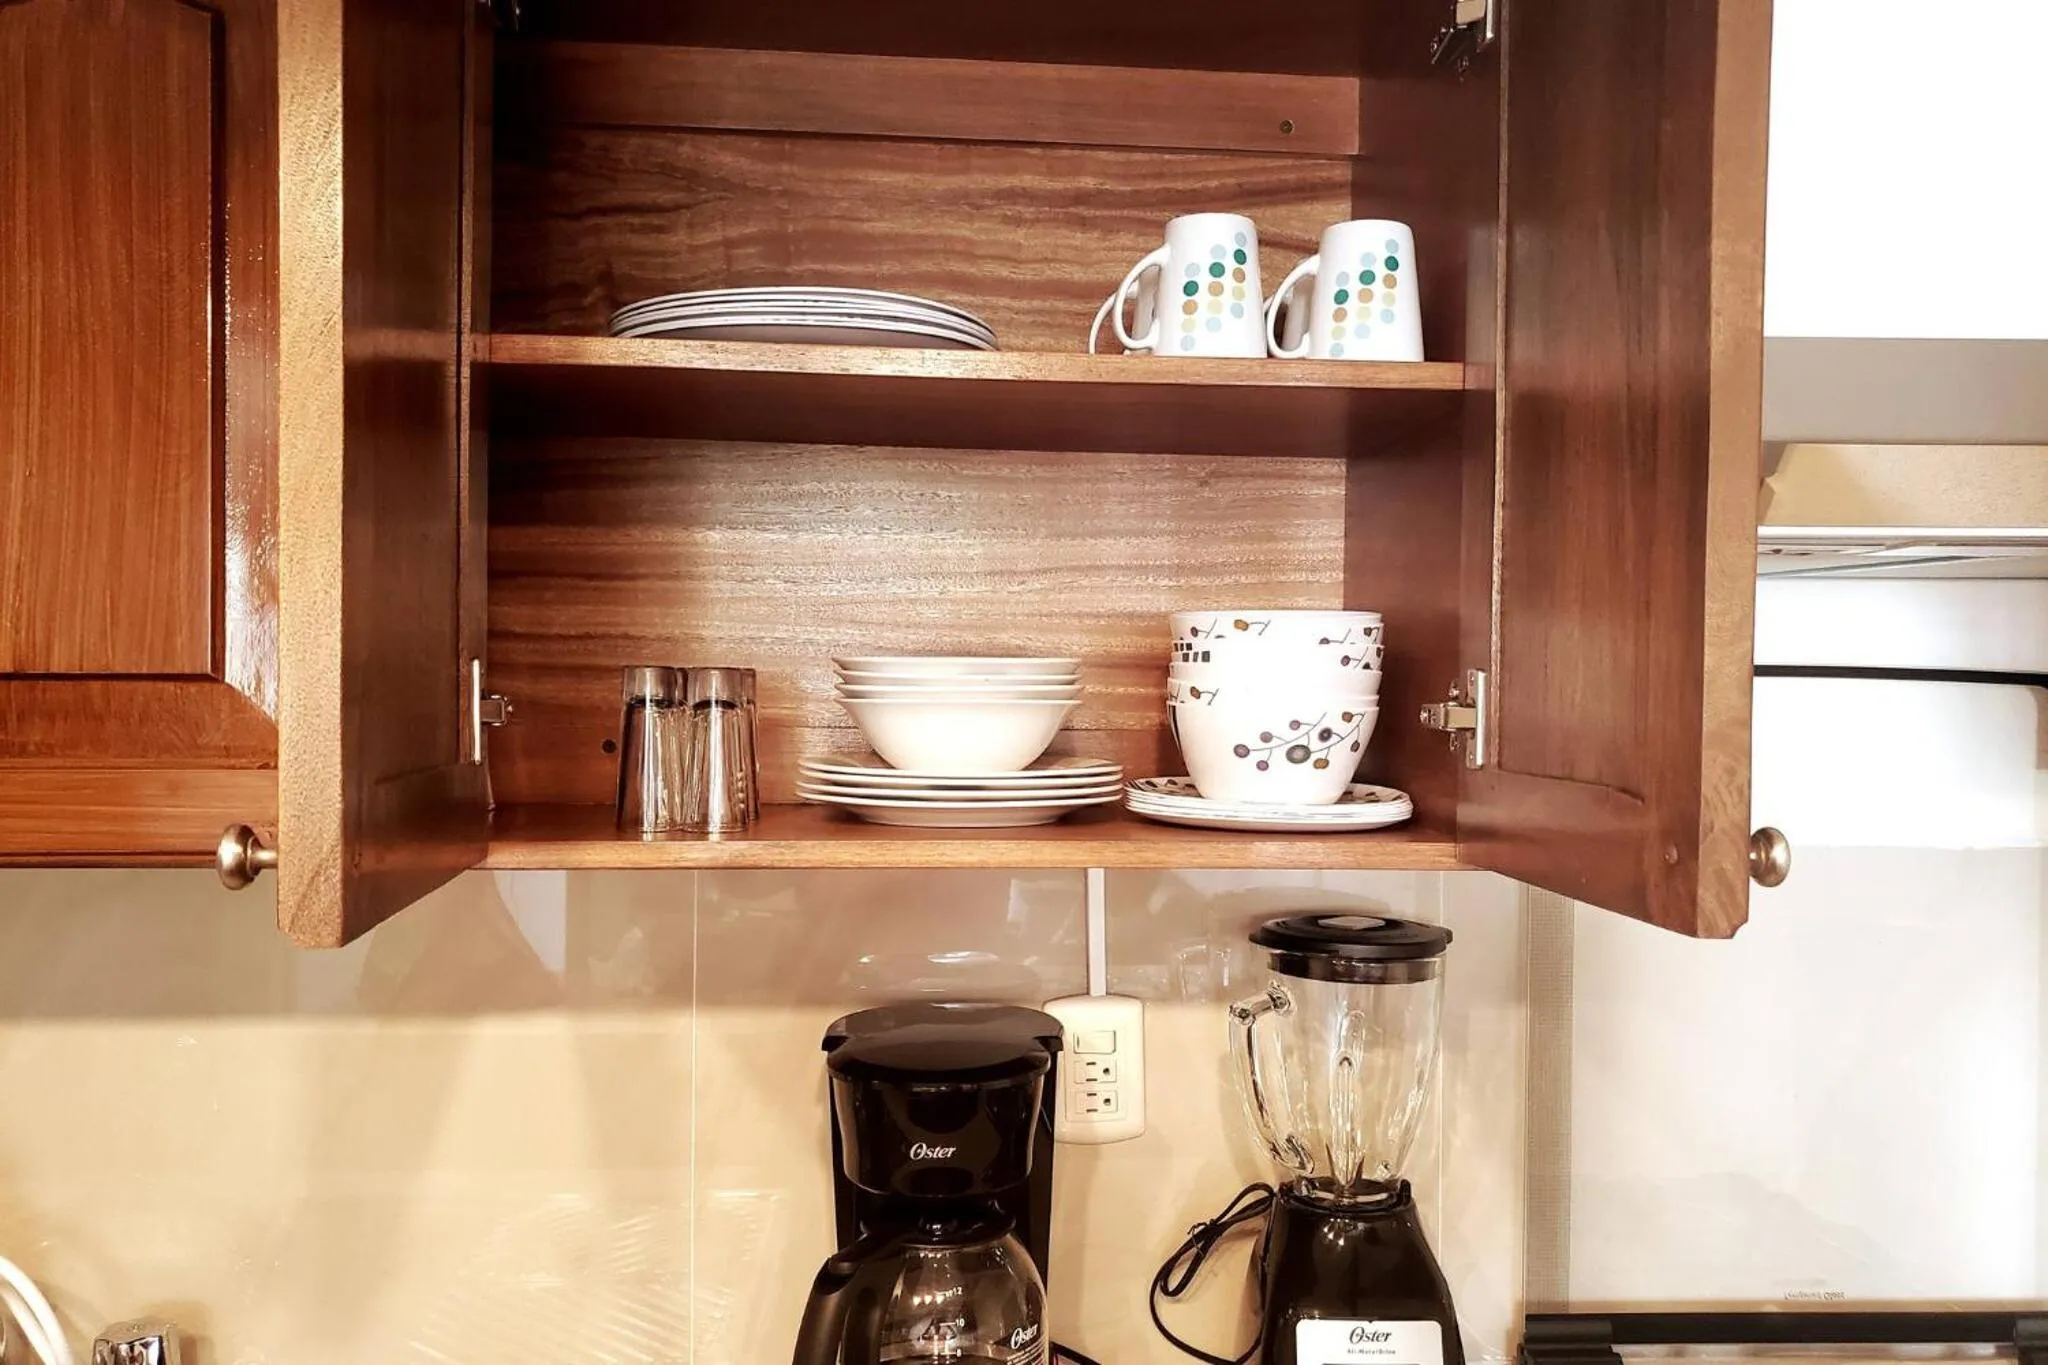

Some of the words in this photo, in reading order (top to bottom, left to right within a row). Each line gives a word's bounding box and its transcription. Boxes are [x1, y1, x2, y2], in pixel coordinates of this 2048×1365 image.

[909, 1142, 957, 1161] Oster
[1011, 1323, 1039, 1350] Oster
[1349, 1326, 1392, 1345] Oster
